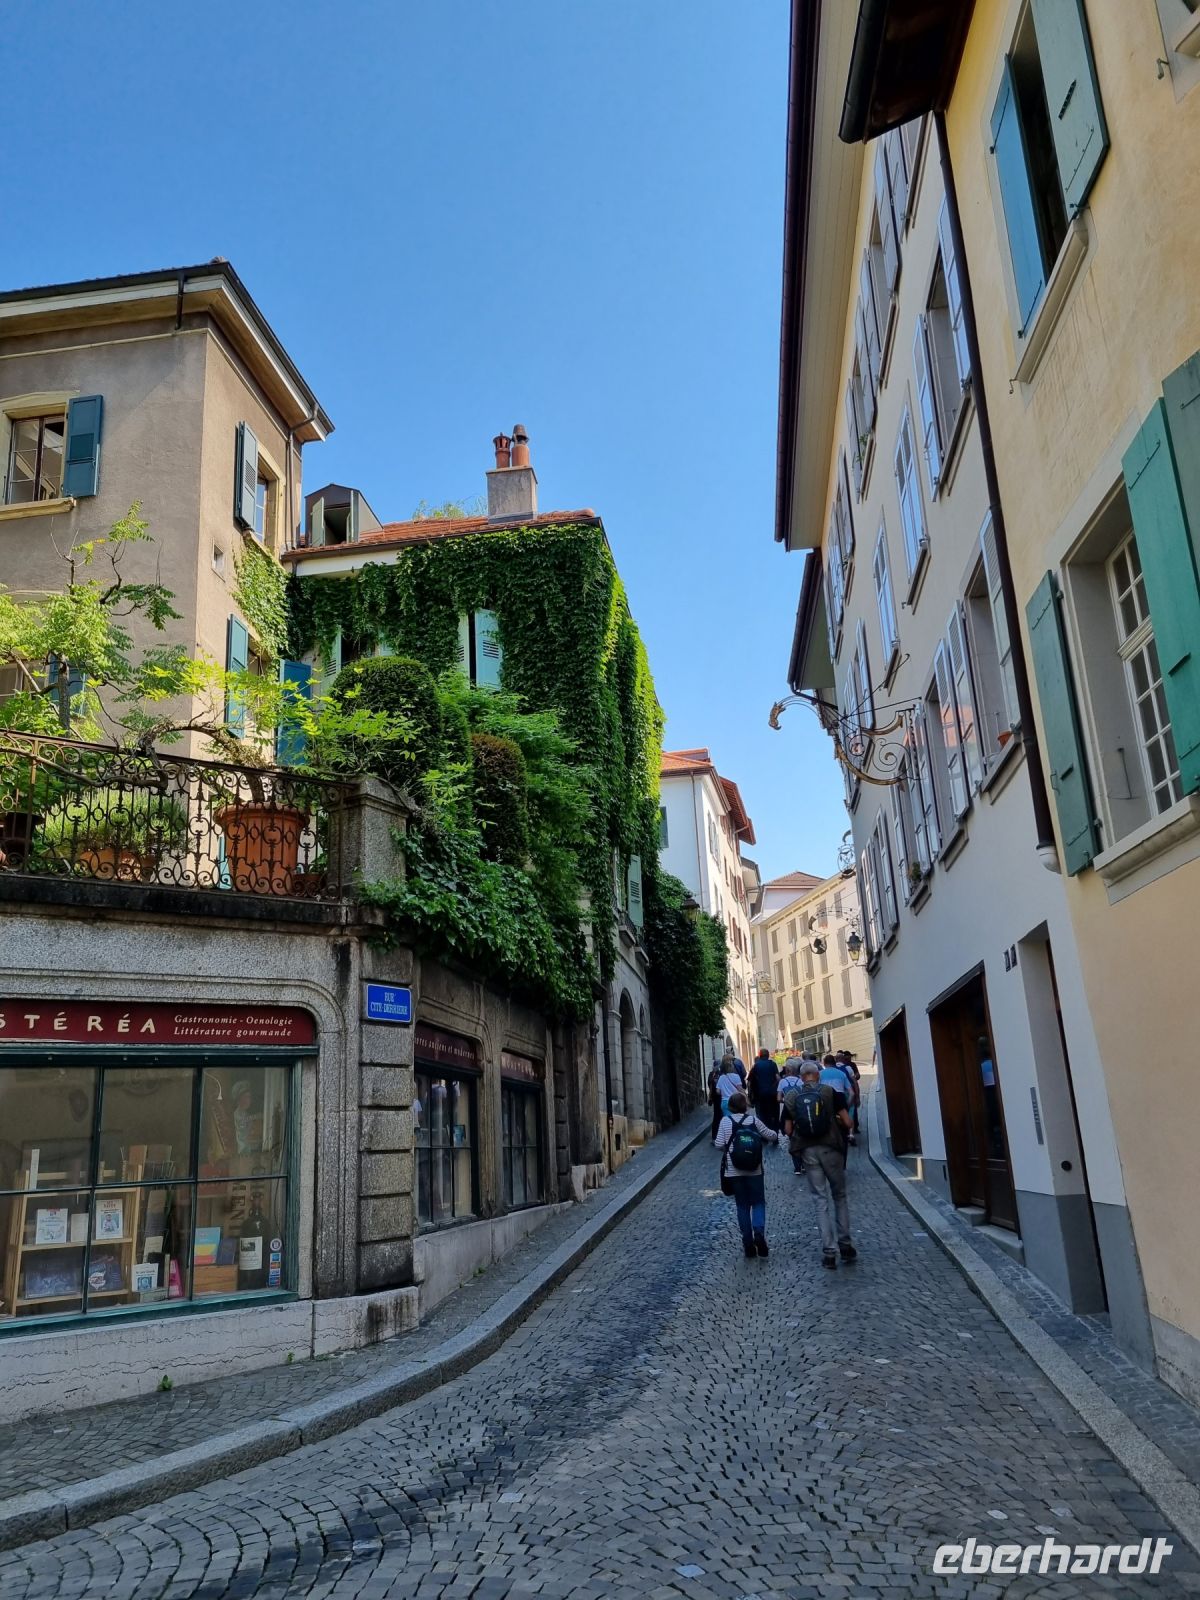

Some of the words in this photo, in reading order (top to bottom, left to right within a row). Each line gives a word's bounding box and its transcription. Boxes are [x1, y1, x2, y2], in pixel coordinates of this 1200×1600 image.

[384, 992, 395, 1002] RUE
[174, 1014, 237, 1024] Gastronomie
[246, 1016, 293, 1026] Oenologie
[174, 1026, 232, 1036] Littérature
[236, 1028, 292, 1037] gourmande
